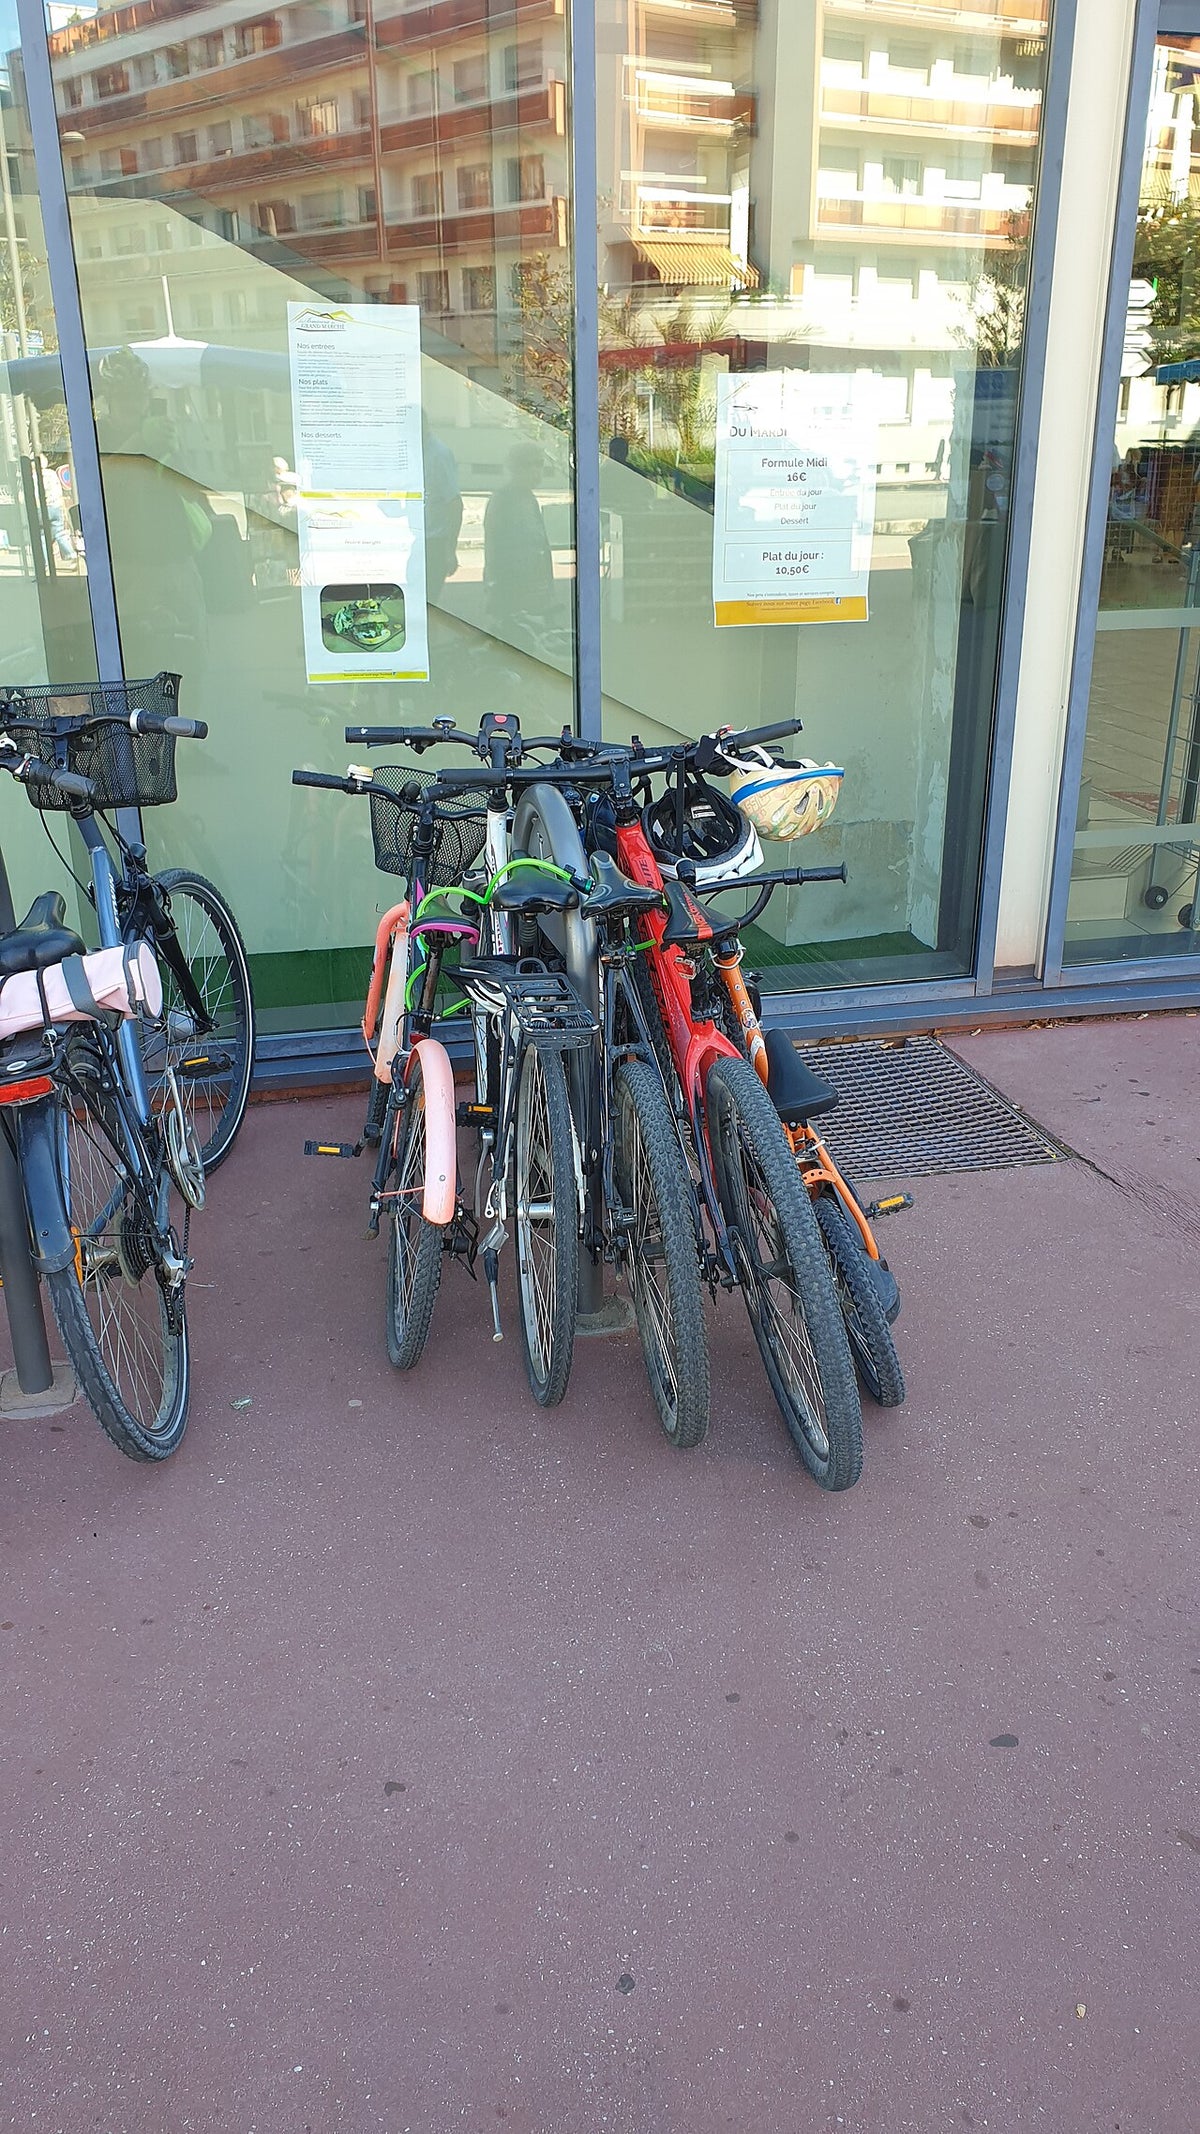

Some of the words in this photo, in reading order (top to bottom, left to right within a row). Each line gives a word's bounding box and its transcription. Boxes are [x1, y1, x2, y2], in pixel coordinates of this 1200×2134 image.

[301, 431, 314, 439] Nos
[761, 457, 804, 468] Formule
[806, 457, 828, 468] Midi
[787, 471, 807, 482] 16€
[797, 489, 806, 497] du
[807, 489, 823, 498] jour
[774, 503, 789, 511] Plat
[790, 503, 801, 511] du
[801, 503, 817, 512] jour
[780, 517, 809, 525] Dessert
[762, 551, 782, 561] Plat
[784, 551, 797, 561] du
[798, 550, 819, 562] jour
[775, 564, 810, 576] 10,50€
